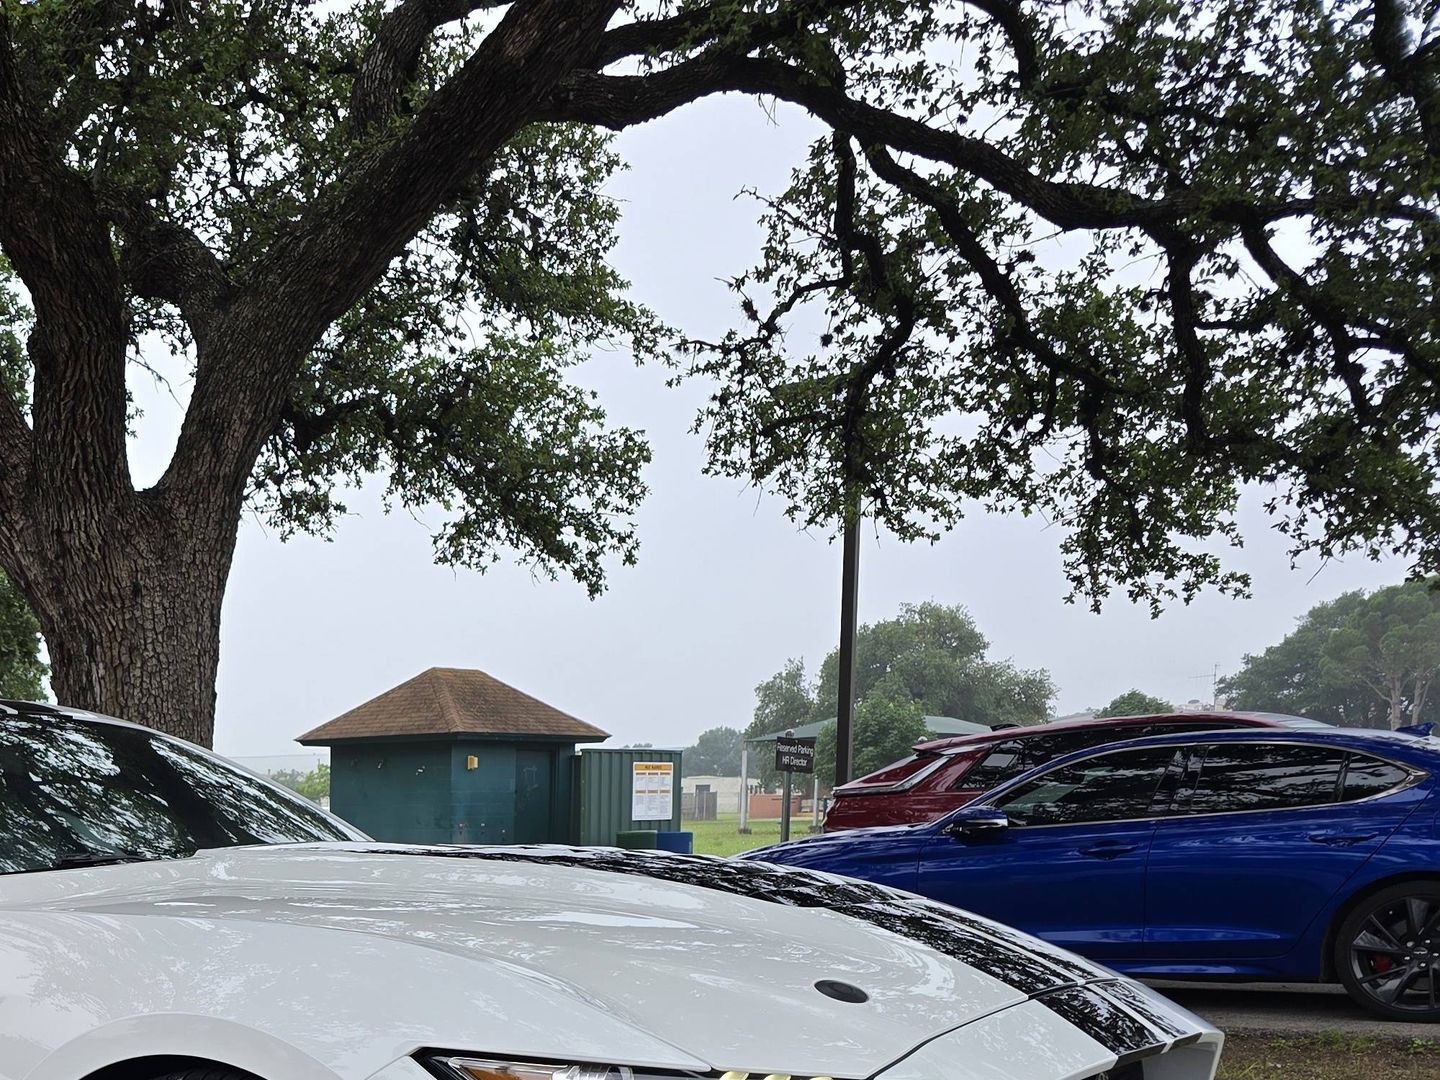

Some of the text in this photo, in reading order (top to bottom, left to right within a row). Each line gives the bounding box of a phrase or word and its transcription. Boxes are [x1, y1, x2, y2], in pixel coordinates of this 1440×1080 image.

[777, 742, 813, 757] Reserved Parking
[782, 756, 807, 766] HR Director
